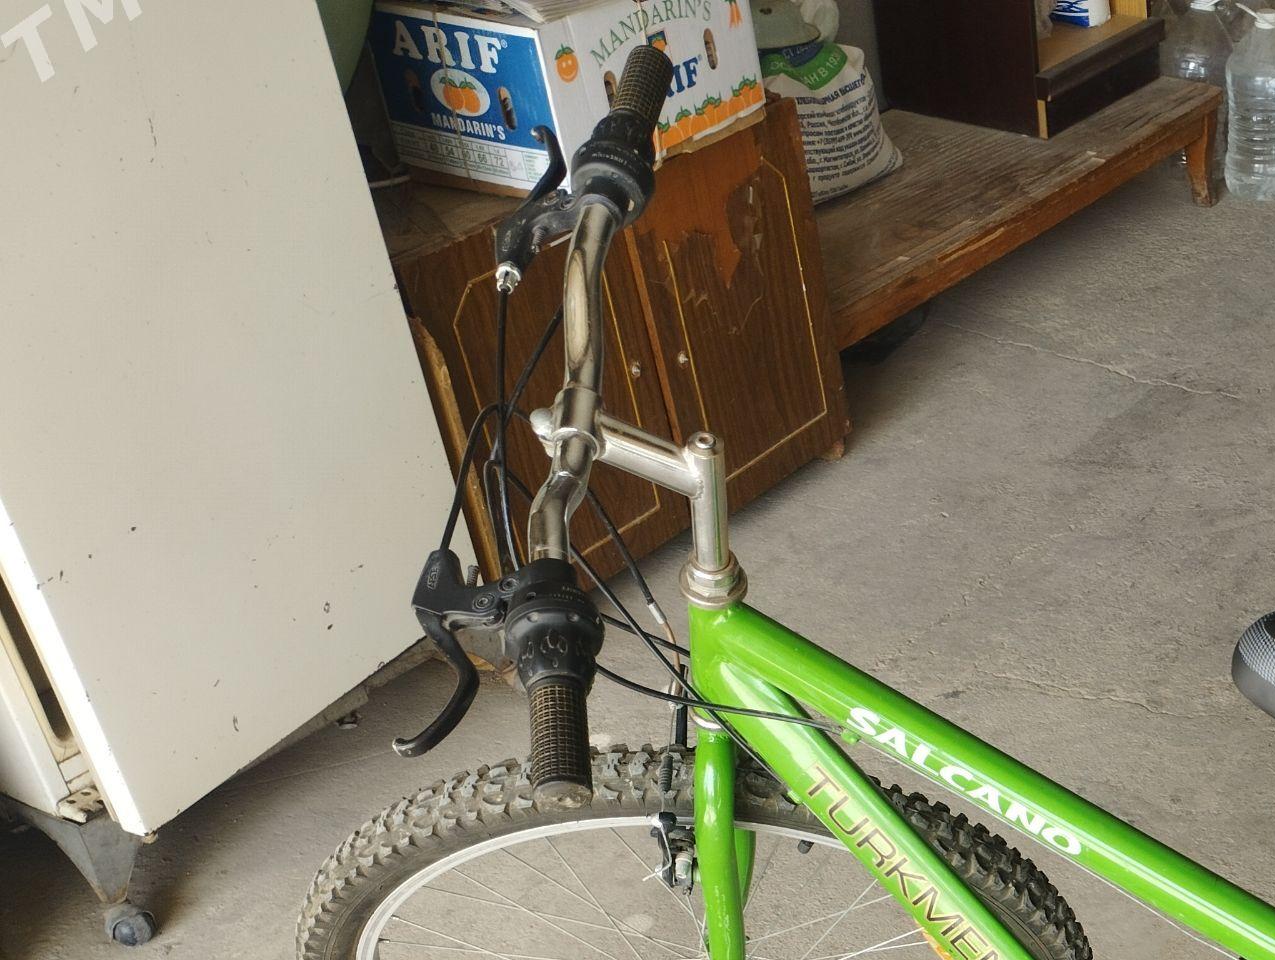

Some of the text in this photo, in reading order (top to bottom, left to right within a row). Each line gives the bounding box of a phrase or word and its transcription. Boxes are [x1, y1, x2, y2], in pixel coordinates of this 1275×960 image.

[392, 20, 502, 74] ARIF
[431, 113, 506, 141] MANDARIN'S
[846, 706, 1082, 856] SALCANO
